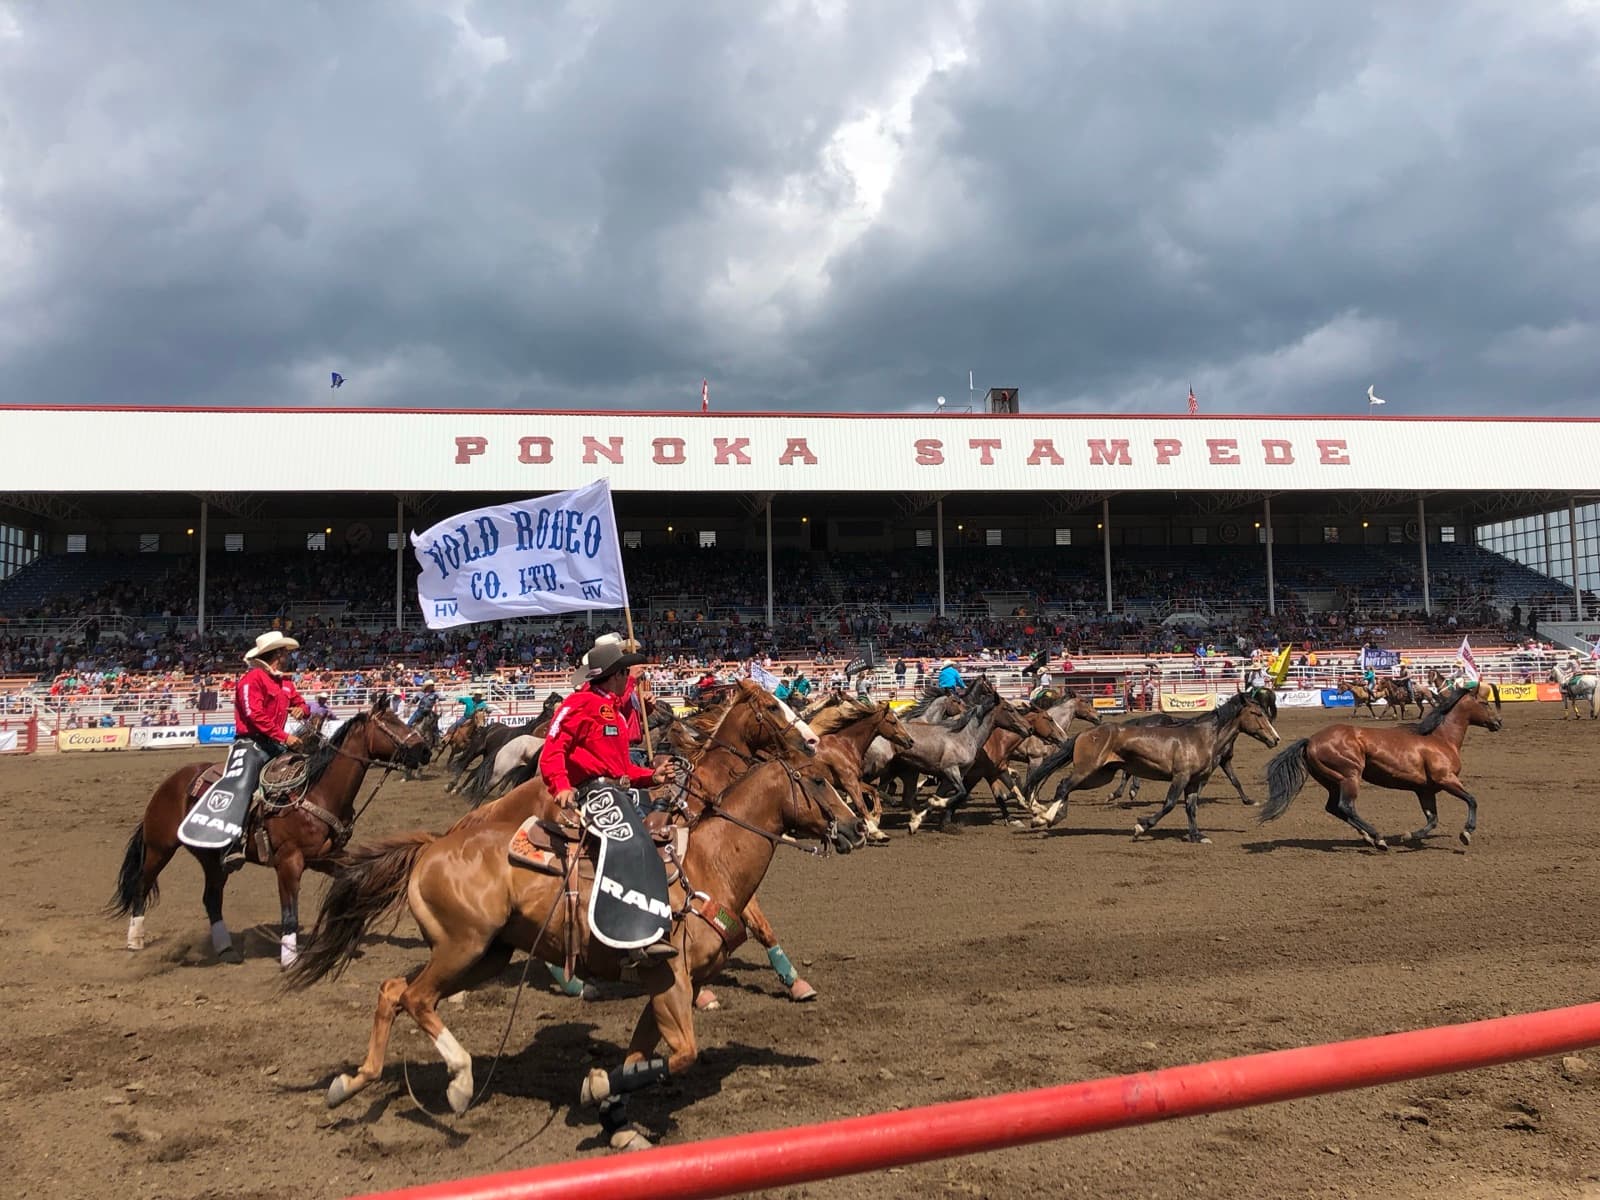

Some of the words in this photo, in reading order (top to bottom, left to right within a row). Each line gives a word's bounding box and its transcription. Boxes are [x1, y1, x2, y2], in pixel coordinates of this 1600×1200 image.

[454, 436, 818, 465] PONOKA
[913, 437, 1351, 466] STAMPEDE
[424, 515, 500, 580] VOLD
[510, 507, 603, 559] RODEO
[470, 570, 508, 601] CO.
[518, 562, 565, 596] LTD.
[581, 582, 603, 601] HV
[434, 601, 458, 618] HV
[1365, 656, 1399, 667] MOTORS
[1168, 697, 1196, 708] Coors
[68, 733, 102, 745] Coors
[151, 730, 196, 739] RAM
[210, 726, 230, 736] ATB
[224, 748, 248, 778] RAM
[190, 813, 242, 838] RAM
[600, 876, 673, 921] RAM
